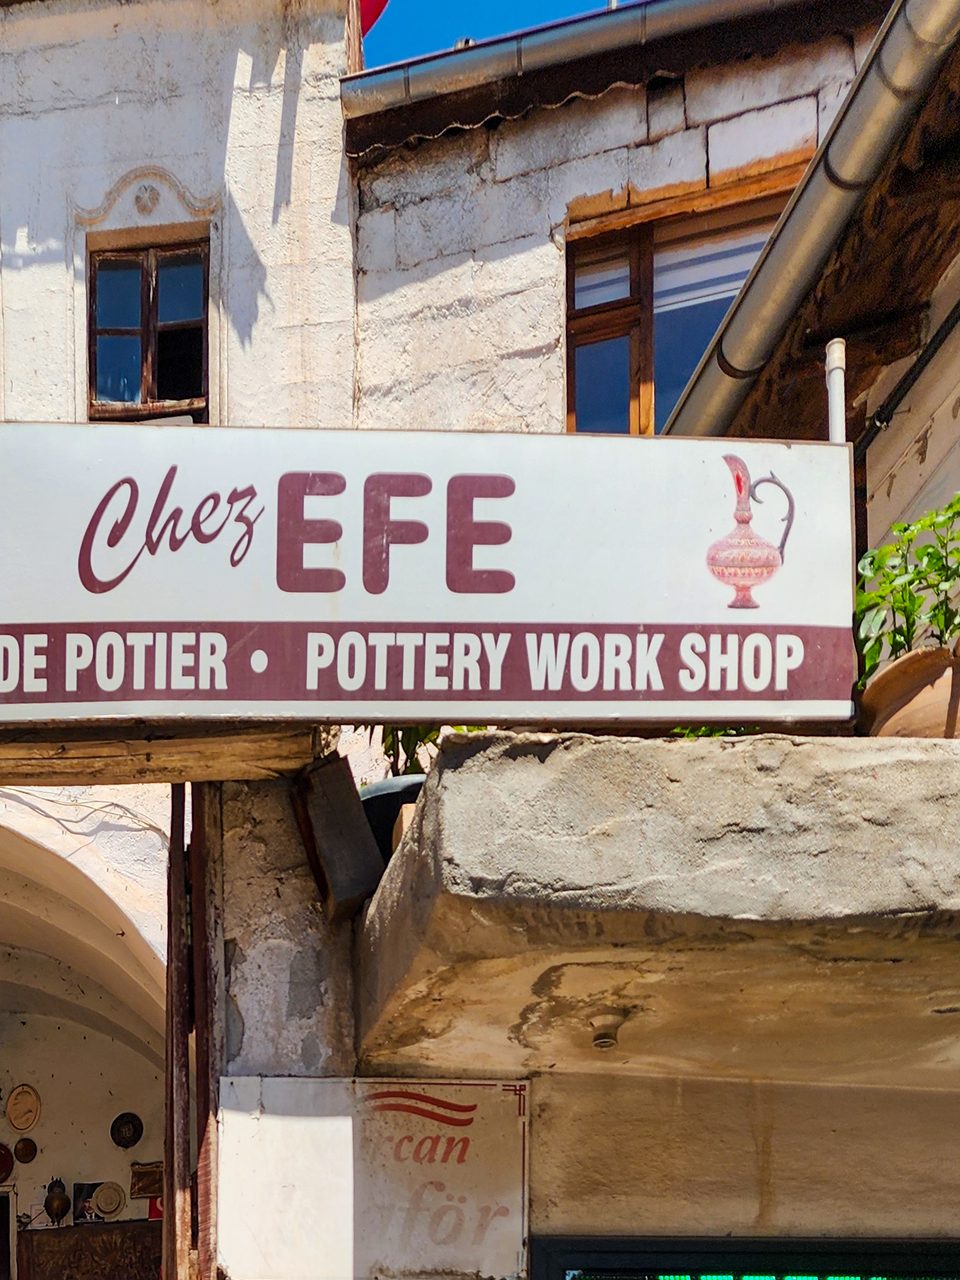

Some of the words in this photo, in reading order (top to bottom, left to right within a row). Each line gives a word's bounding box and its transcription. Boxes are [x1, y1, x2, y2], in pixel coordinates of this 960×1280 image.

[77, 463, 266, 594] Chez
[276, 470, 517, 595] EFE
[65, 630, 229, 691] POTIER
[305, 631, 513, 692] POTTERY
[524, 632, 665, 693] WORK
[677, 632, 806, 693] SHOP
